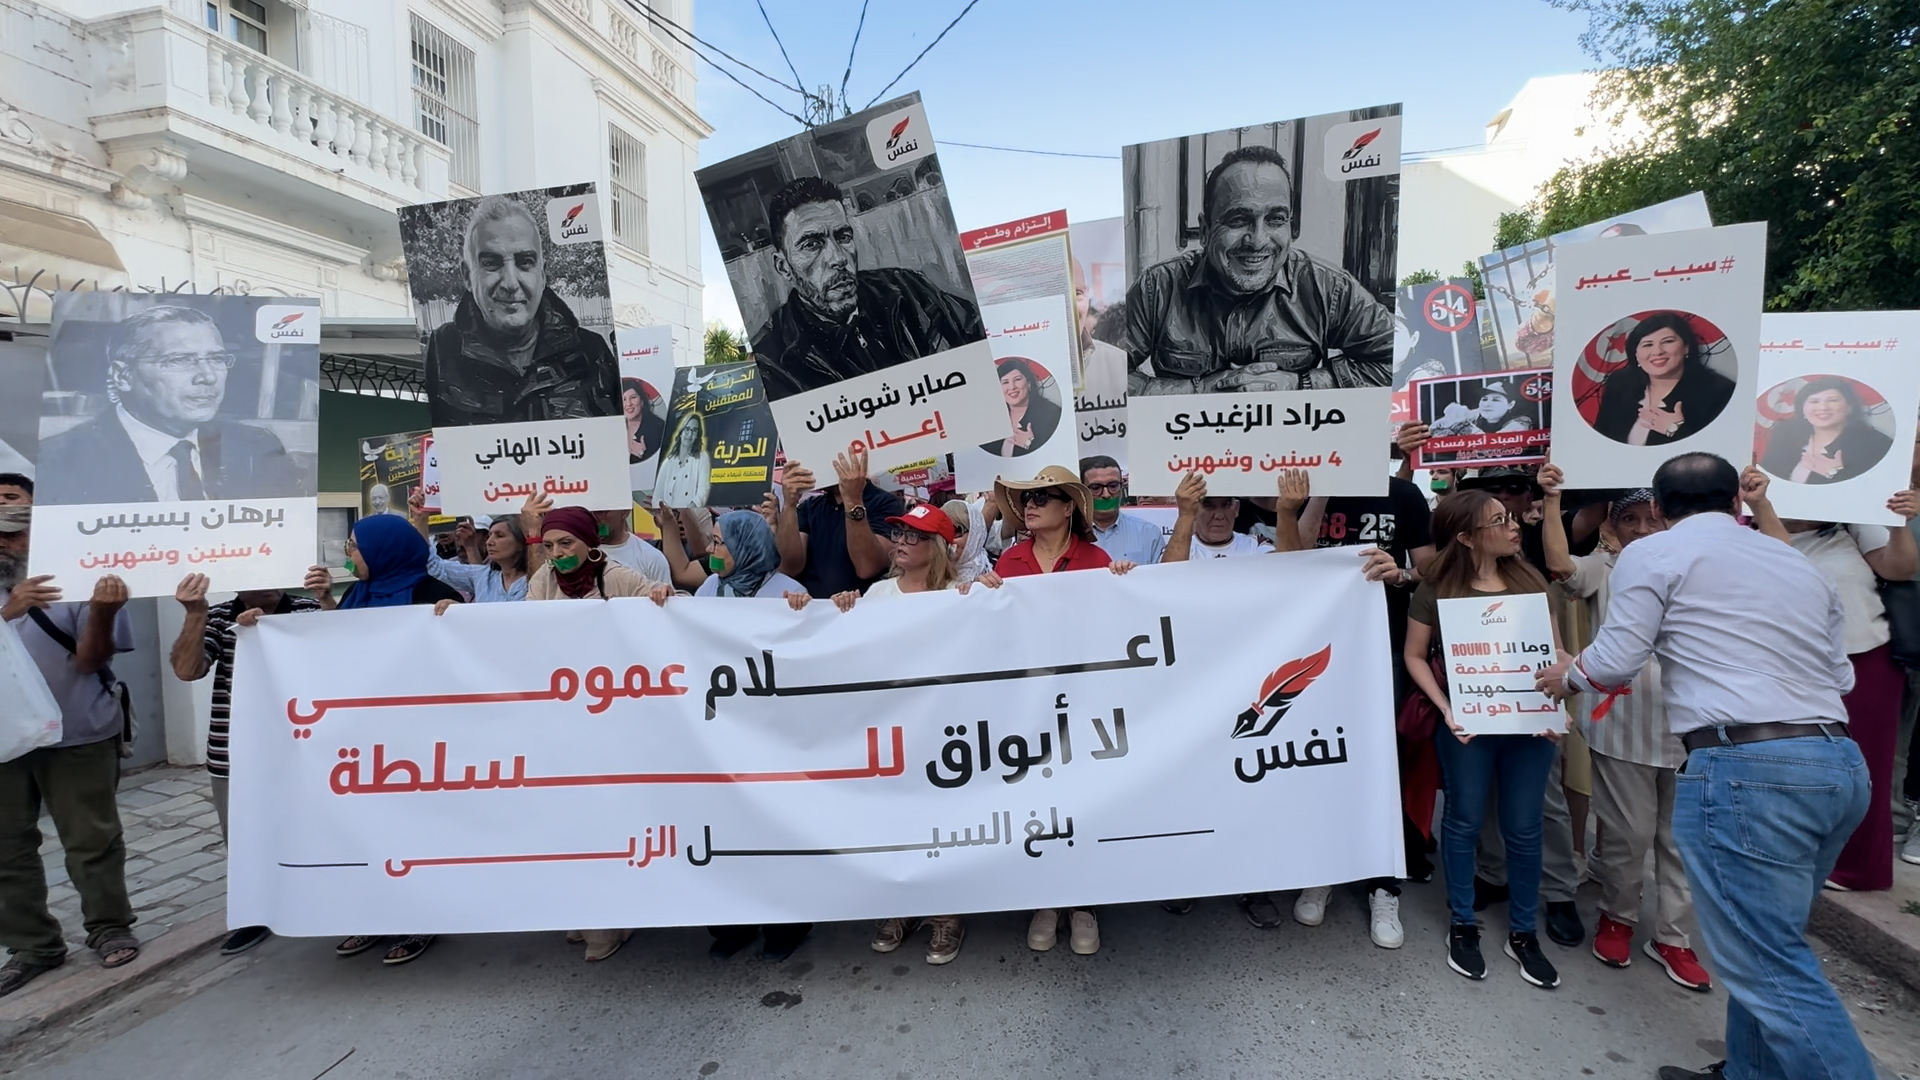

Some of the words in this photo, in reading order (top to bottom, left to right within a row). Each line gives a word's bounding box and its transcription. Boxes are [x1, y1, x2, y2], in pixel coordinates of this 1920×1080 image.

[887, 138, 918, 161] نفس
[1341, 153, 1381, 173] نفس
[561, 223, 588, 239] نفس
[973, 228, 1011, 248] وطني
[270, 328, 304, 339] نفس
[706, 368, 755, 391] الحرية
[907, 371, 967, 406] صابر
[704, 387, 753, 412] للمعتقلين
[805, 383, 901, 433] شوشان
[1165, 403, 1273, 440] الزغيدي
[1282, 402, 1346, 432] مراد
[848, 410, 947, 454] إعدام
[1080, 417, 1127, 442] ونحن
[475, 436, 540, 469] الهاني
[547, 432, 585, 459] زياد
[713, 437, 768, 465] الحرية
[1433, 439, 1465, 449] فساد
[1167, 449, 1253, 475] وشهرين
[1259, 450, 1322, 472] سنين
[1327, 450, 1342, 467] 4
[483, 481, 537, 503] سجن
[543, 475, 589, 494] سنة
[77, 511, 190, 536] بسيس
[200, 504, 285, 529] برهان
[79, 544, 180, 569] وشهرين
[187, 543, 253, 563] سنين
[258, 542, 273, 556] 4
[1481, 615, 1507, 626] نفس
[1451, 642, 1492, 657] ROUND
[1493, 642, 1501, 655] 1
[1521, 641, 1550, 655] وما
[1455, 662, 1531, 675] مقدمة
[286, 663, 689, 739] عمومي
[1458, 683, 1538, 698] مهيدا
[1486, 703, 1512, 717] هو
[1516, 701, 1559, 713] لما
[925, 693, 1074, 789] أبواق
[1089, 707, 1131, 761] لا
[1233, 726, 1349, 784] نفس
[1022, 806, 1076, 858] بلغ
